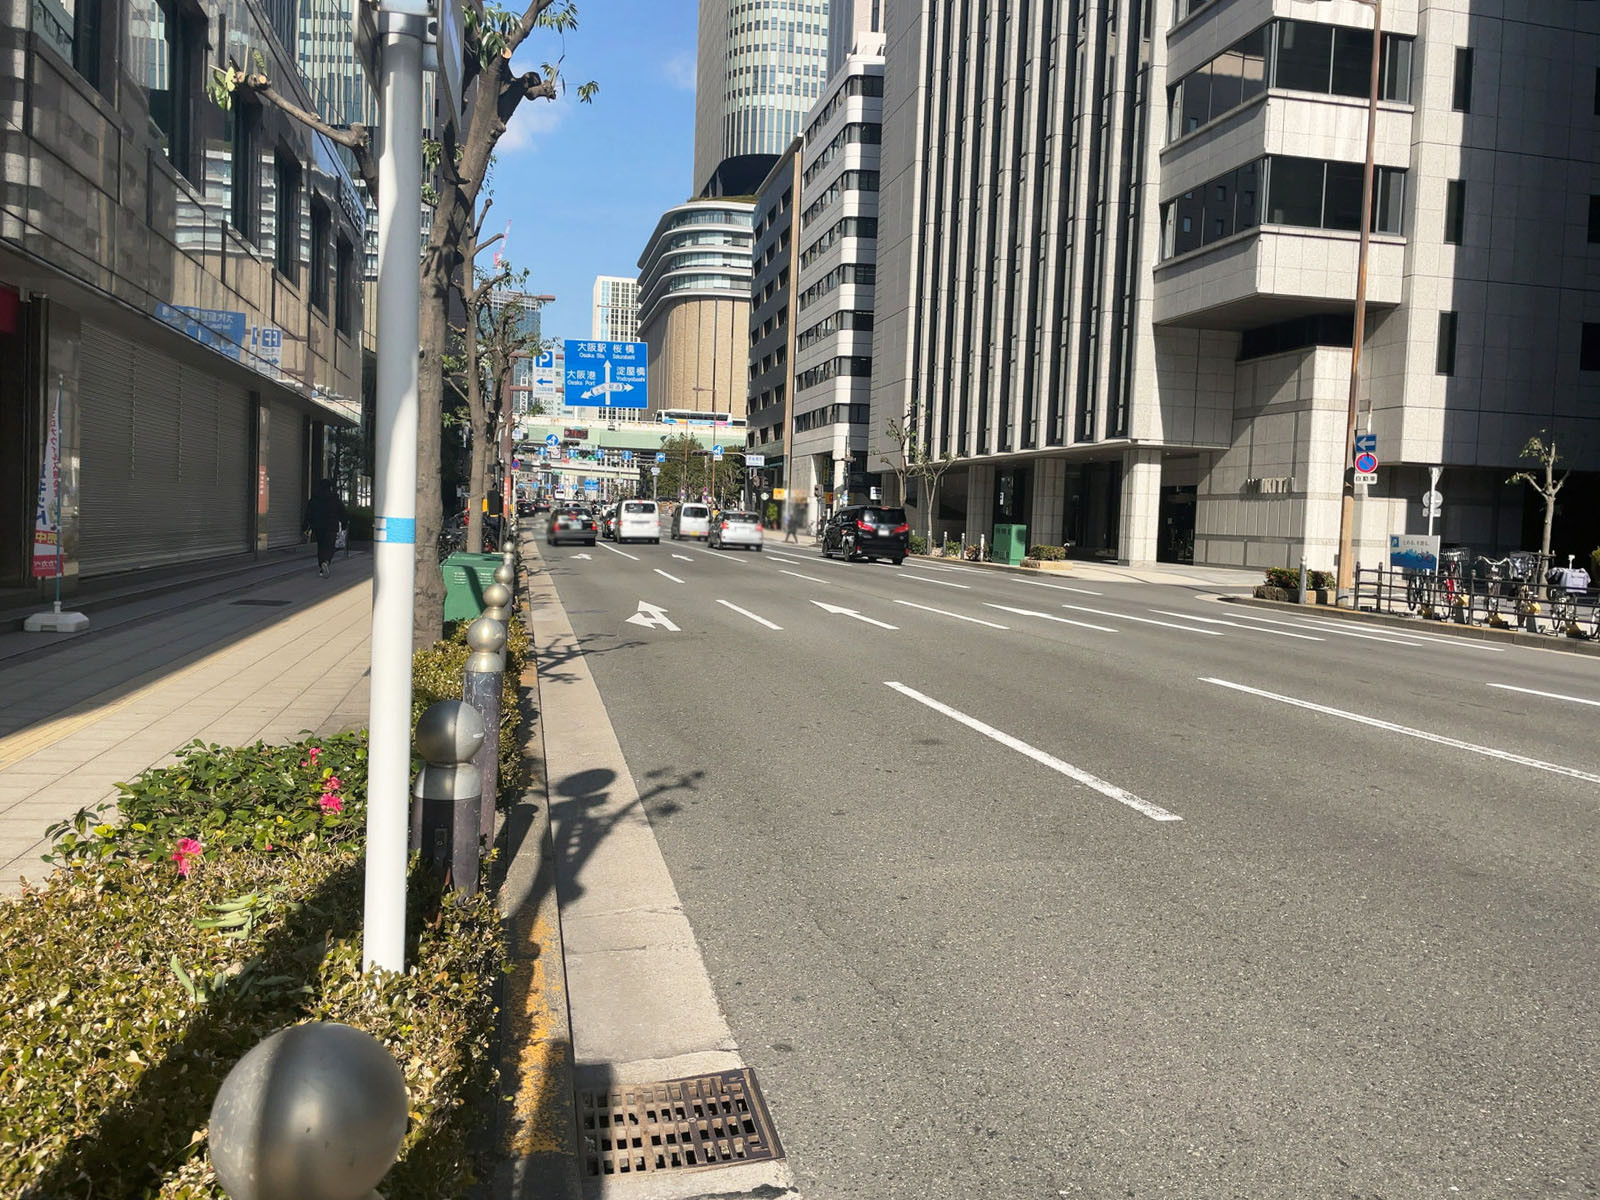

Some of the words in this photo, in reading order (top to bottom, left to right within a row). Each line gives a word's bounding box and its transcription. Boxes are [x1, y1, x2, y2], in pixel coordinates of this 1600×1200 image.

[578, 342, 606, 352] 大阪駅
[567, 369, 596, 380] 大阪港
